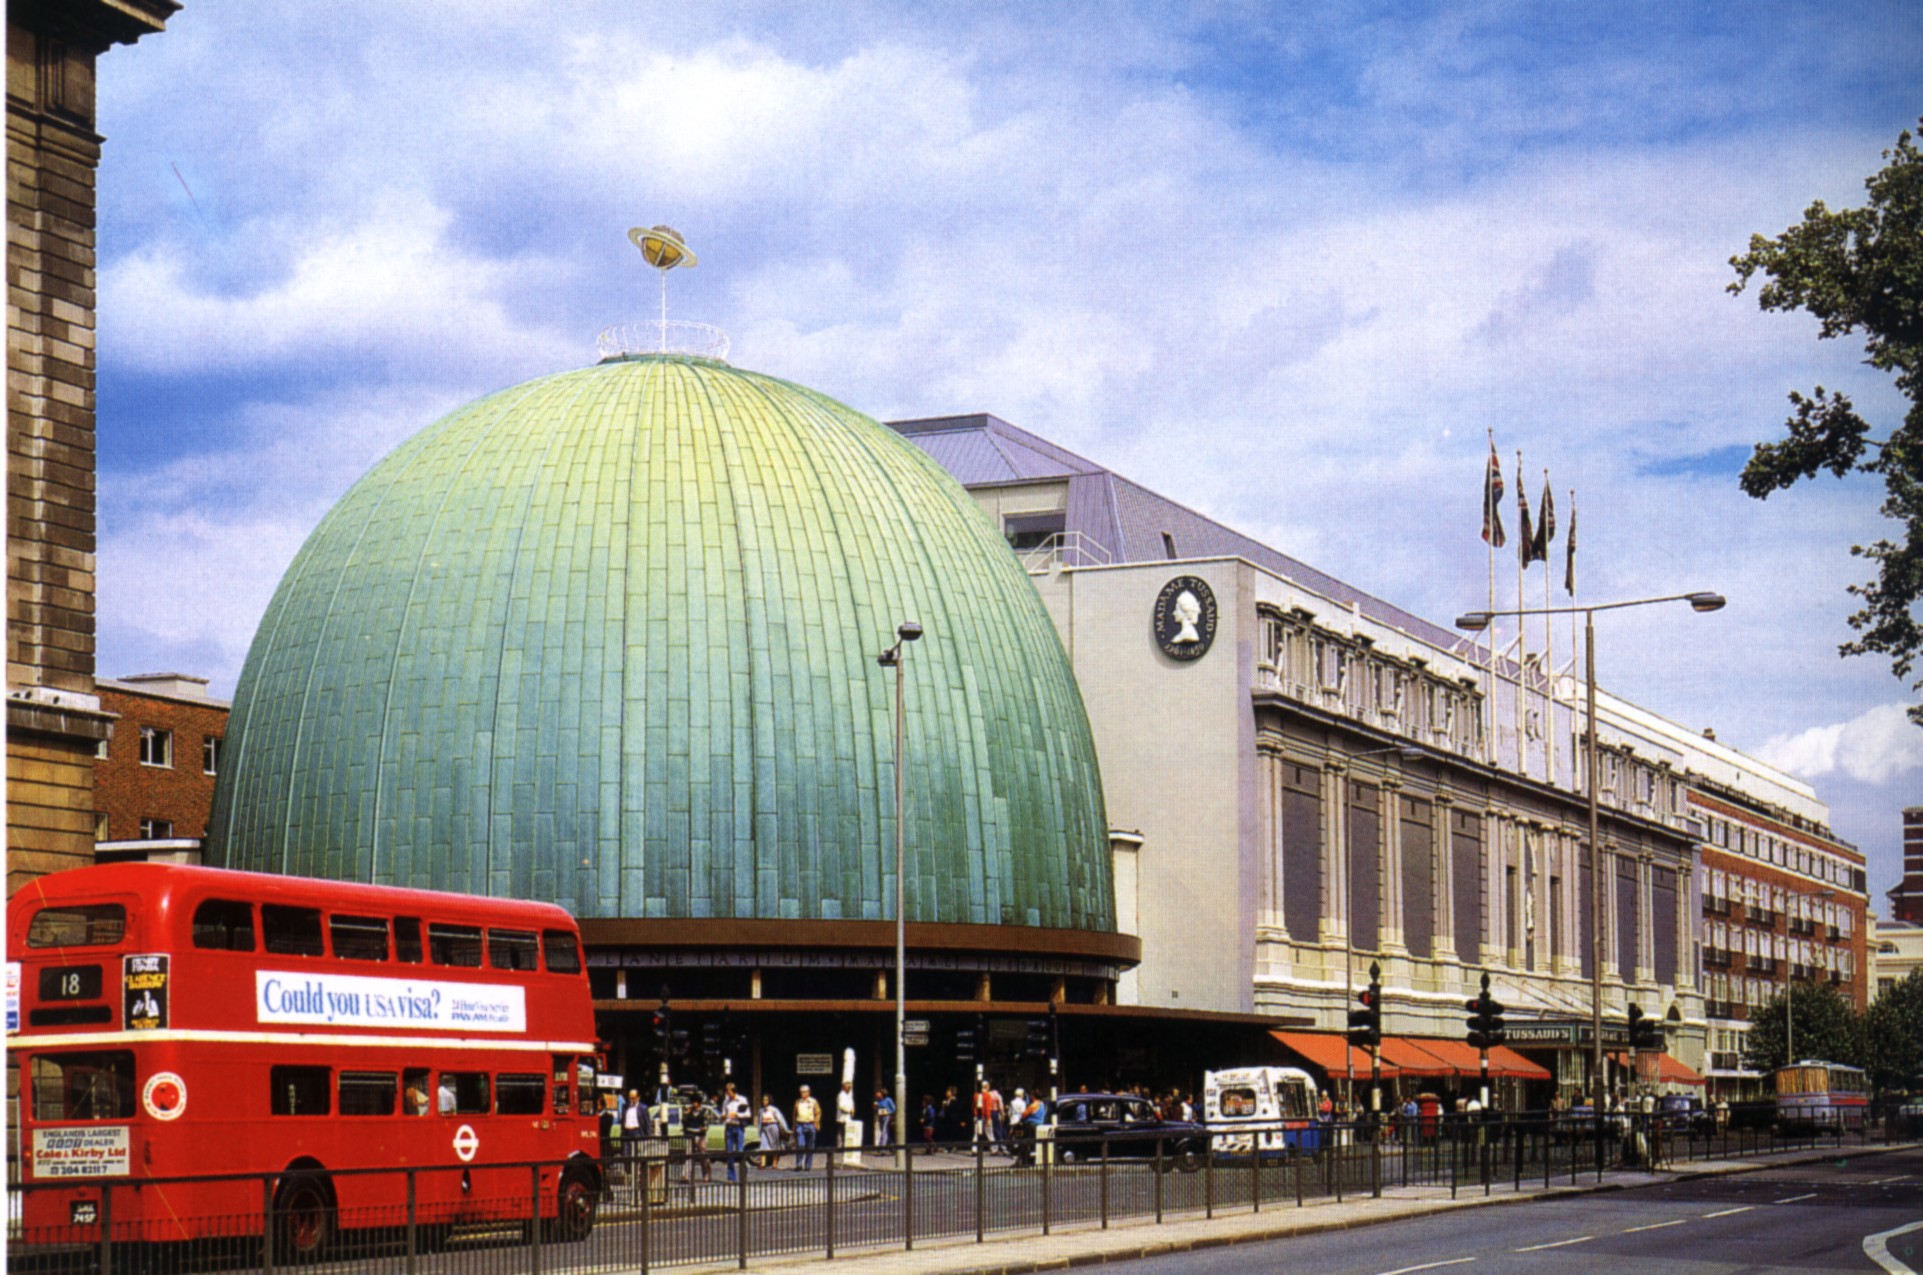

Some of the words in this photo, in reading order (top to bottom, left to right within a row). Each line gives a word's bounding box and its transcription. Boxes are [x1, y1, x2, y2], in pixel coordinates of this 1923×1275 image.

[1156, 579, 1184, 632] MADAME
[1189, 579, 1215, 632] TUSSAUD
[62, 973, 80, 995] 18
[264, 978, 324, 1014] Could
[326, 991, 359, 1022] you
[365, 993, 396, 1018] USA
[398, 987, 441, 1019] visa?
[1505, 1029, 1569, 1040] TUSSAUD'S
[71, 1148, 105, 1159] Kirby
[108, 1147, 126, 1157] Ltd
